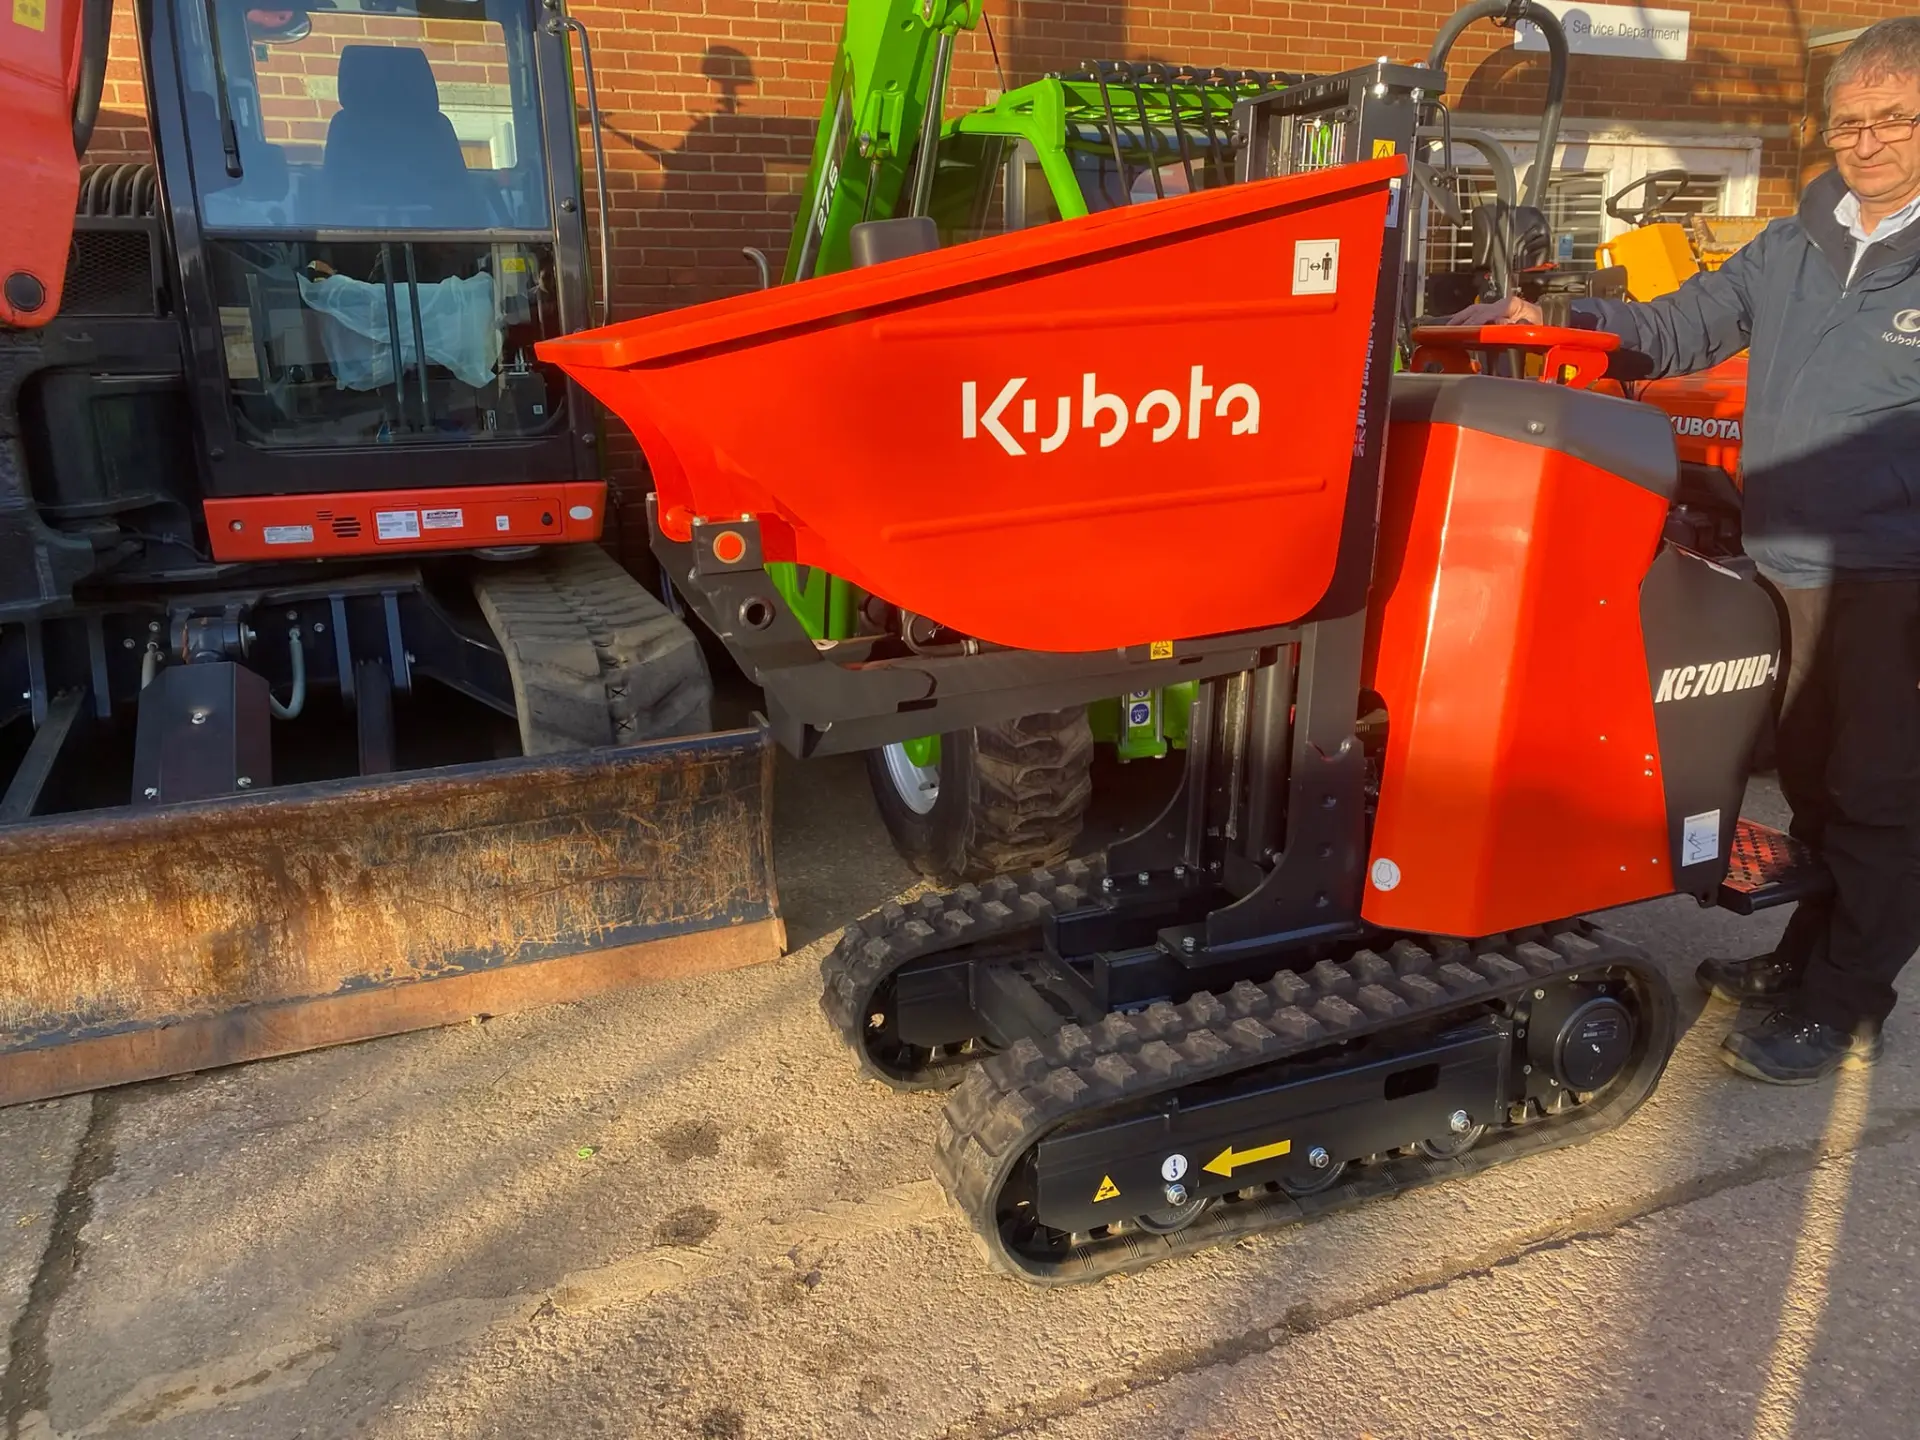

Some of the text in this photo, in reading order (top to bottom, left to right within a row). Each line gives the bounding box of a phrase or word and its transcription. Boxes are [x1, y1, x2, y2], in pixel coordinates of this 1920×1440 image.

[1572, 19, 1614, 36] Service
[1618, 22, 1681, 41] Department
[961, 365, 1260, 456] Kubota
